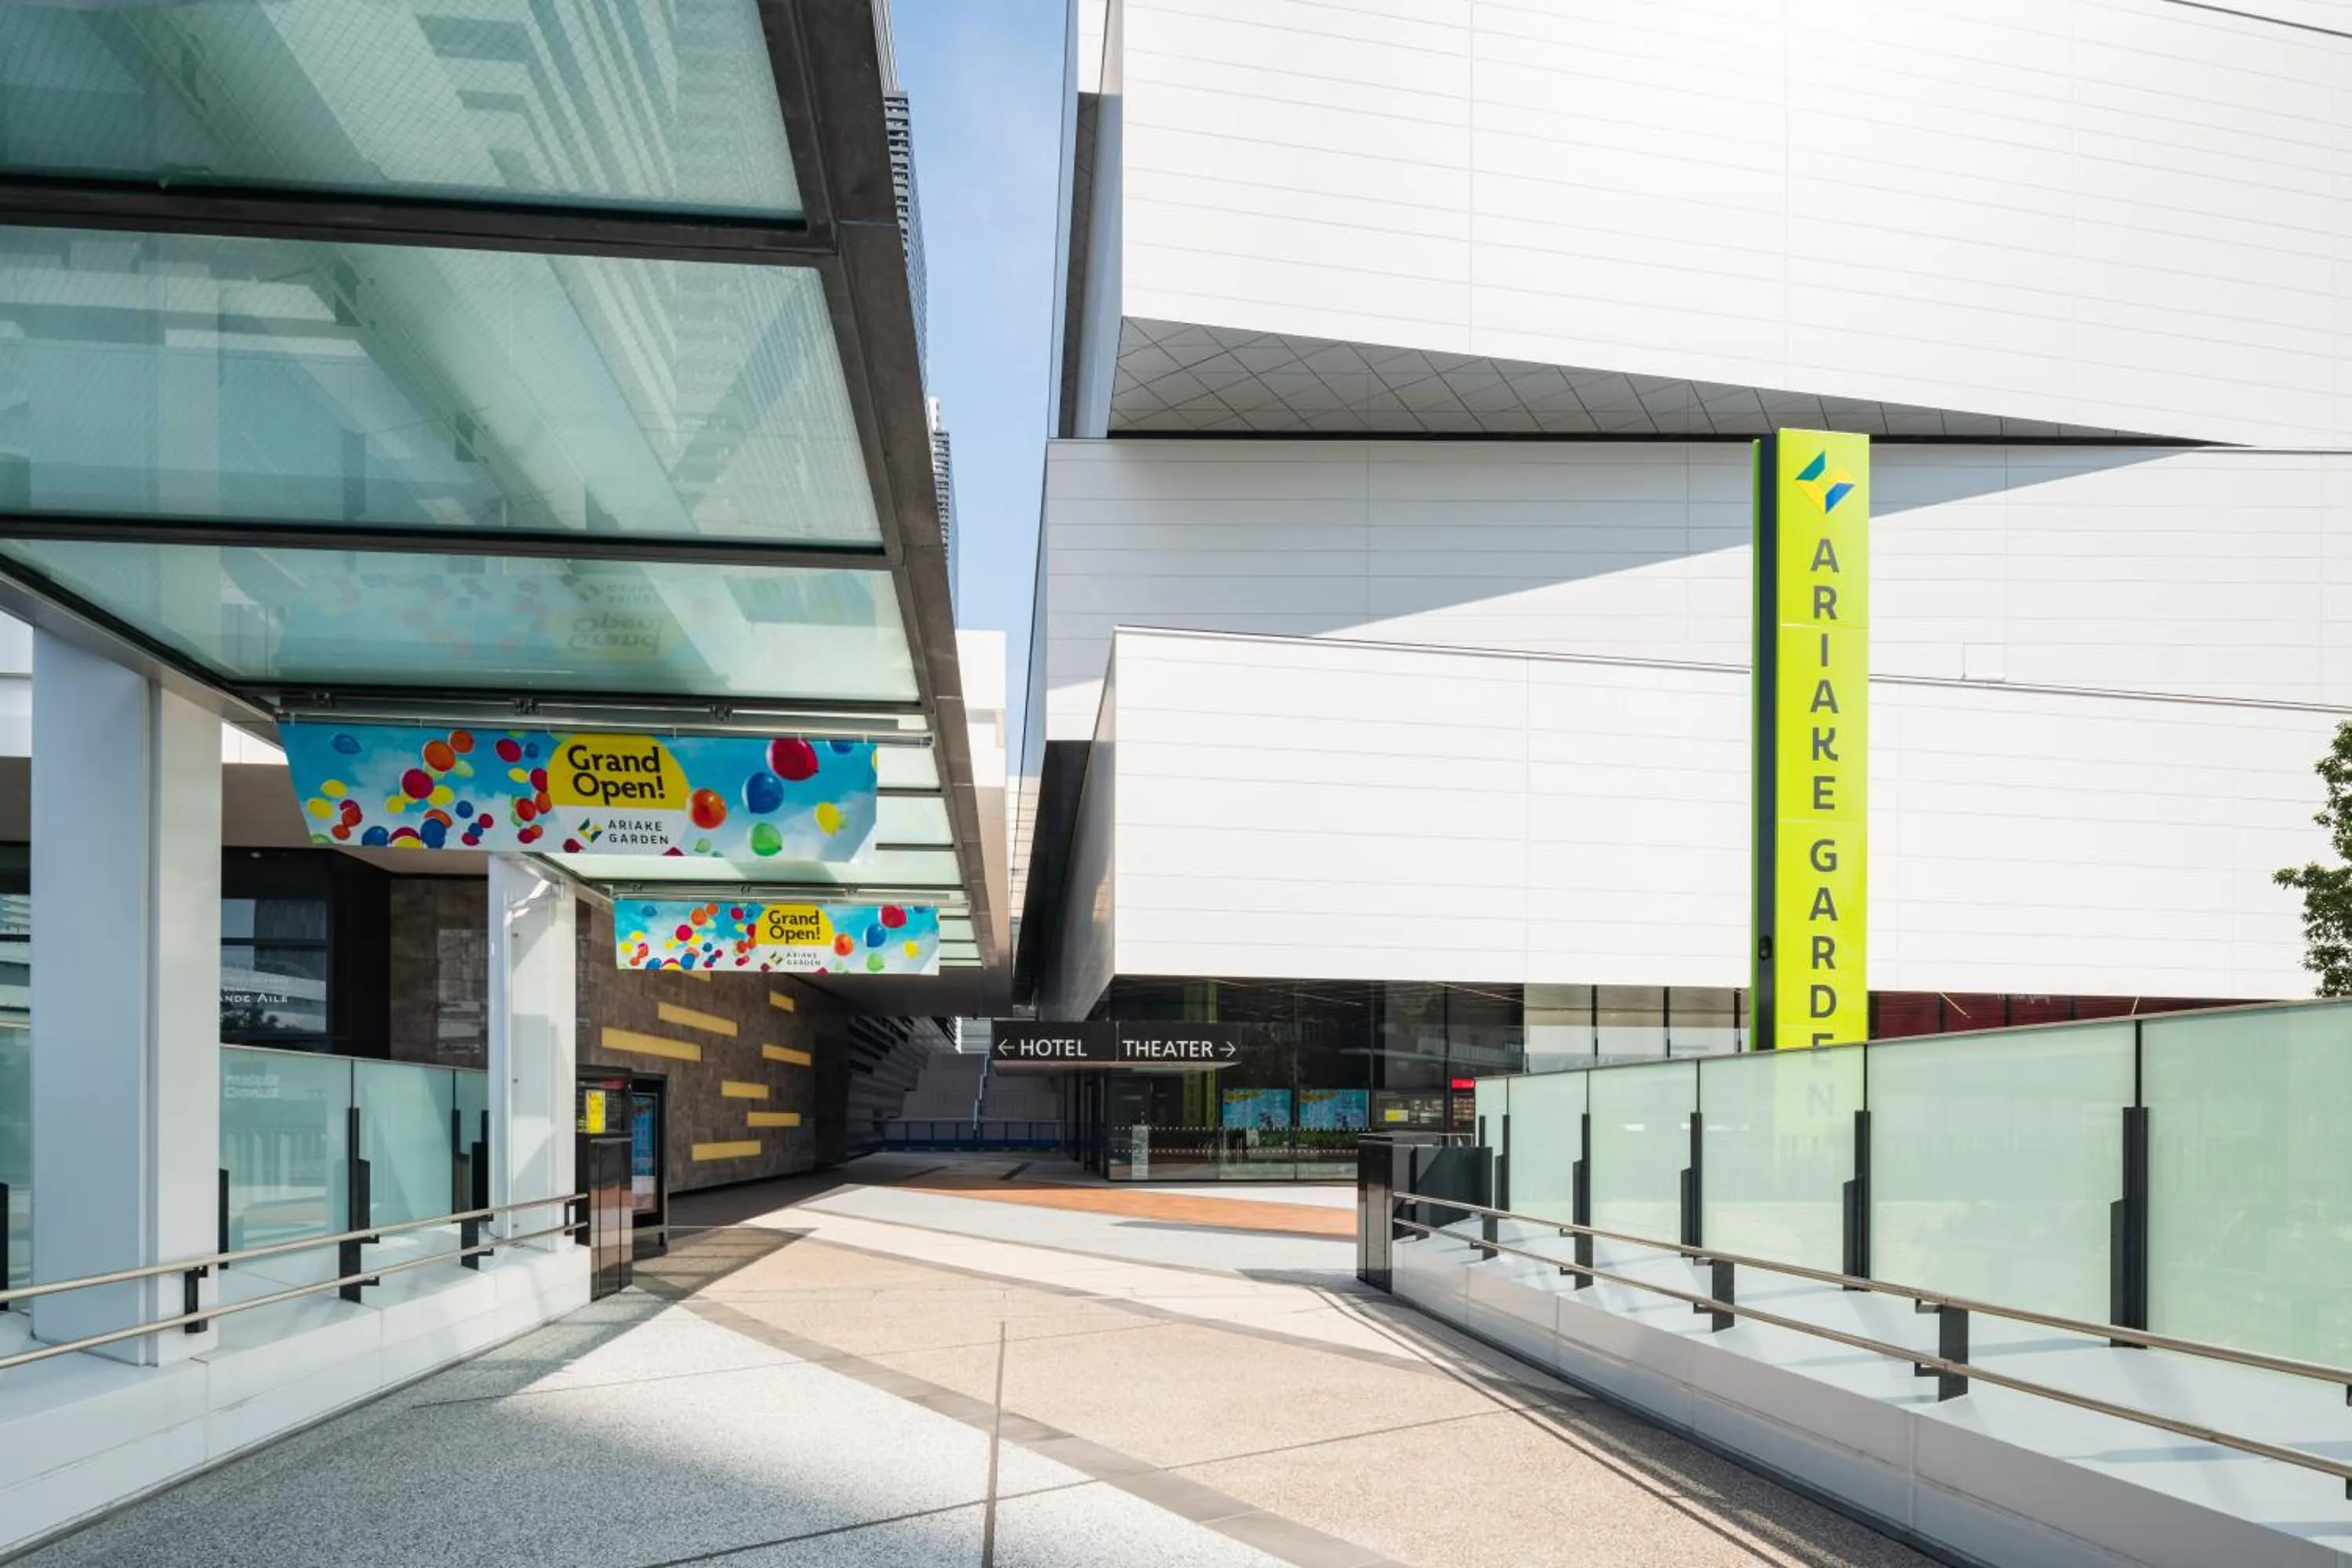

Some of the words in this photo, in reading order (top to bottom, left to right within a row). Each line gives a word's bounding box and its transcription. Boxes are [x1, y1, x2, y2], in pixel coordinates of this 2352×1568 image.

[1809, 538, 1840, 811] ARIAKE
[567, 745, 661, 773] Grand
[572, 771, 665, 806] Open!
[608, 819, 662, 832] ARIAKE
[609, 833, 669, 844] GARDEN
[768, 909, 819, 925] Grand
[769, 924, 820, 945] Open!
[1019, 1039, 1087, 1057] HOTEL
[1122, 1040, 1214, 1058] THEATER
